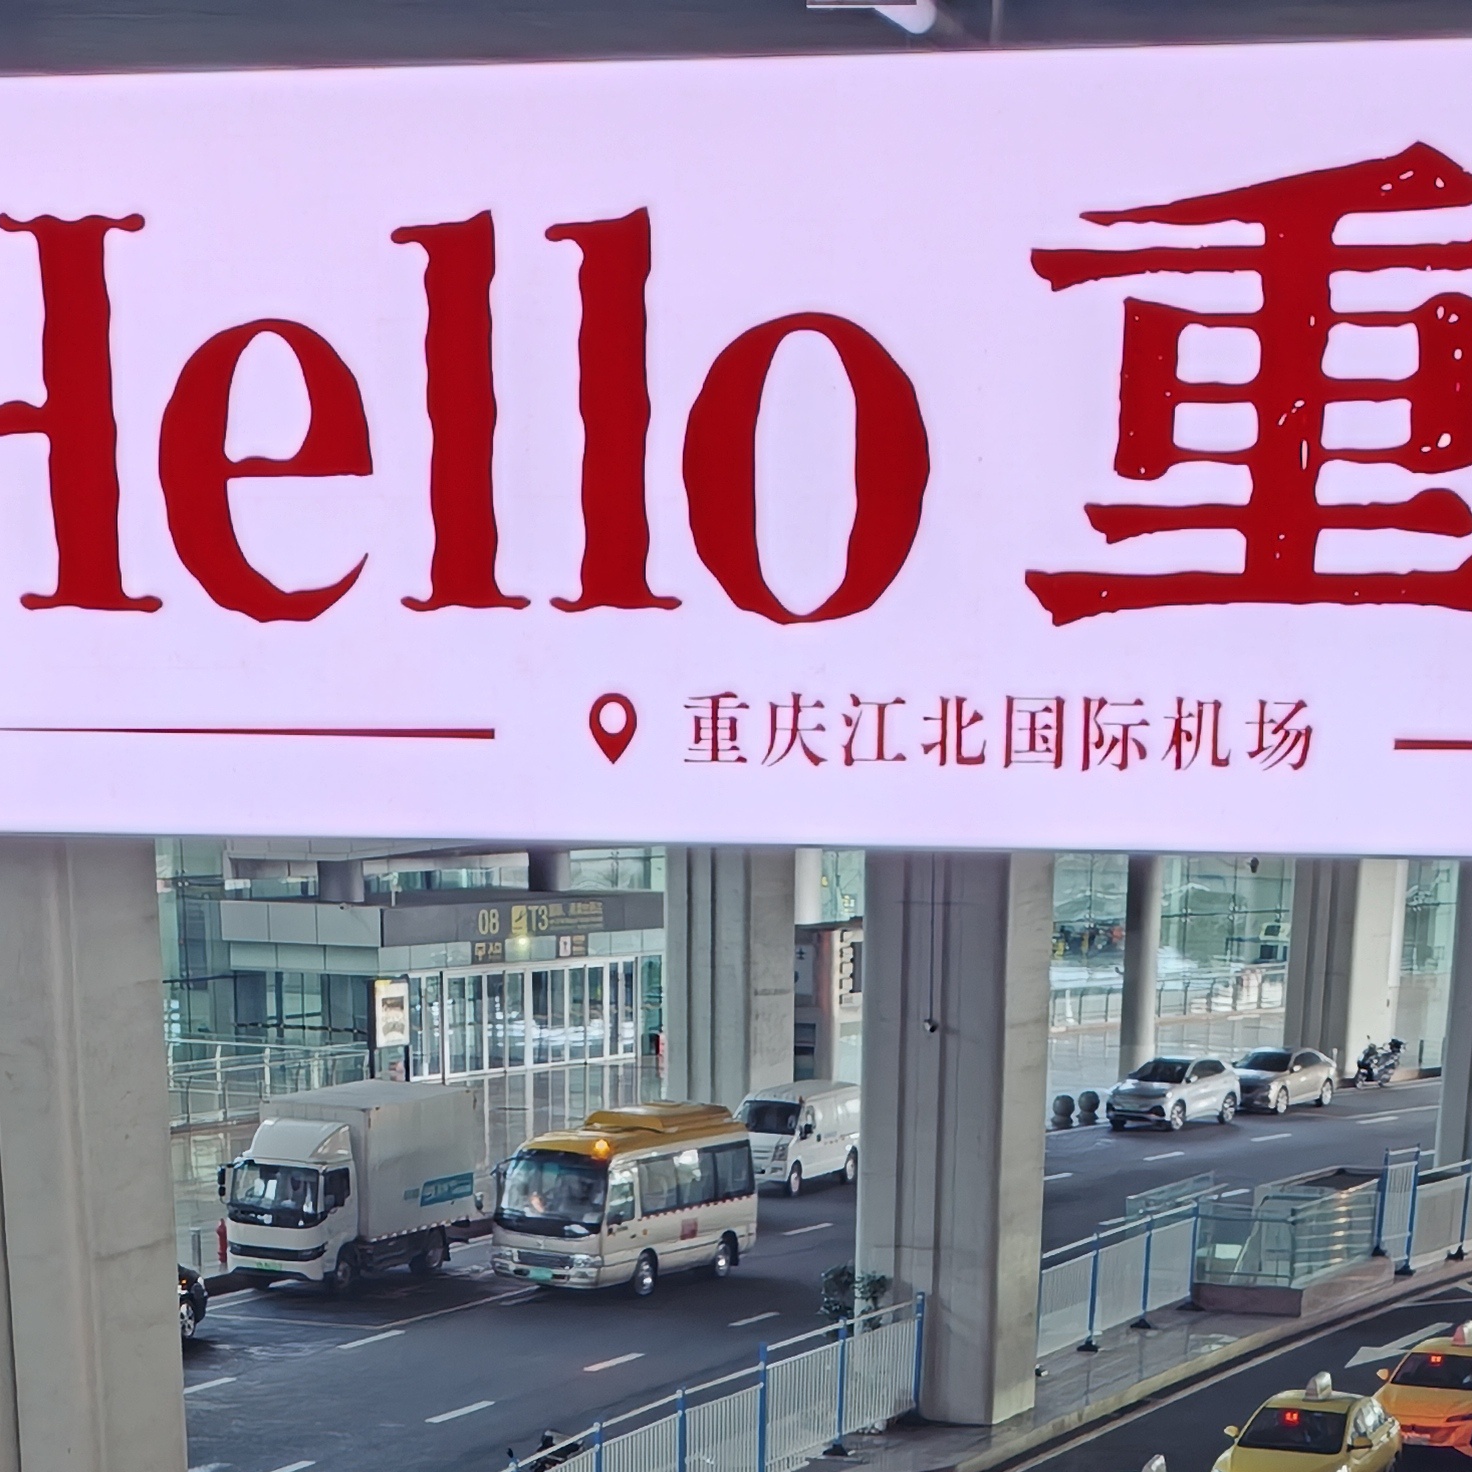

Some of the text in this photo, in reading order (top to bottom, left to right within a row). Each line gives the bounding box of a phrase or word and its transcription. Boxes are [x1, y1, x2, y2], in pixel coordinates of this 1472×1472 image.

[681, 689, 1315, 771] 重庆江北国际机场
[478, 908, 500, 935] 08
